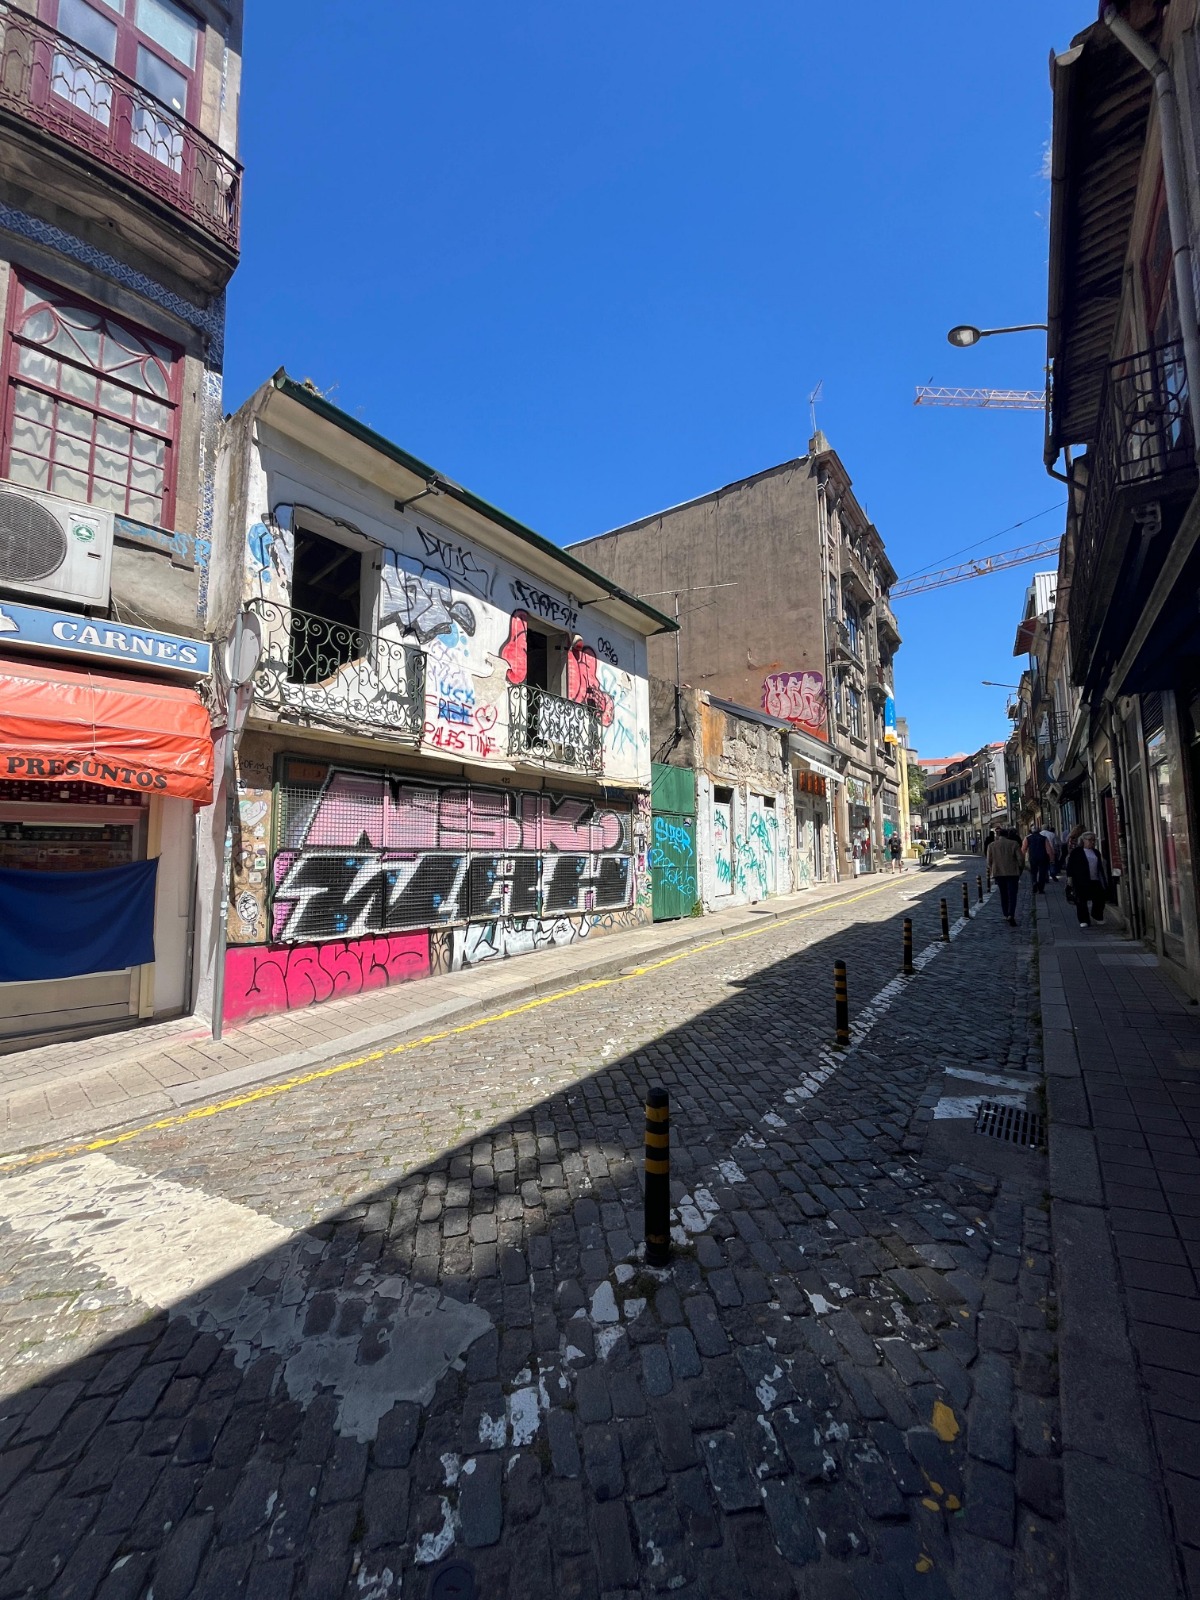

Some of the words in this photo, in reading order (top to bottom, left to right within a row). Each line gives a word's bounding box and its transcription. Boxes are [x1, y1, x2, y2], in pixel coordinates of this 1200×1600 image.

[52, 621, 198, 664] CARNES
[425, 694, 474, 727] FREE
[423, 721, 499, 757] PALESTINE
[6, 756, 168, 789] PRESUNTOS
